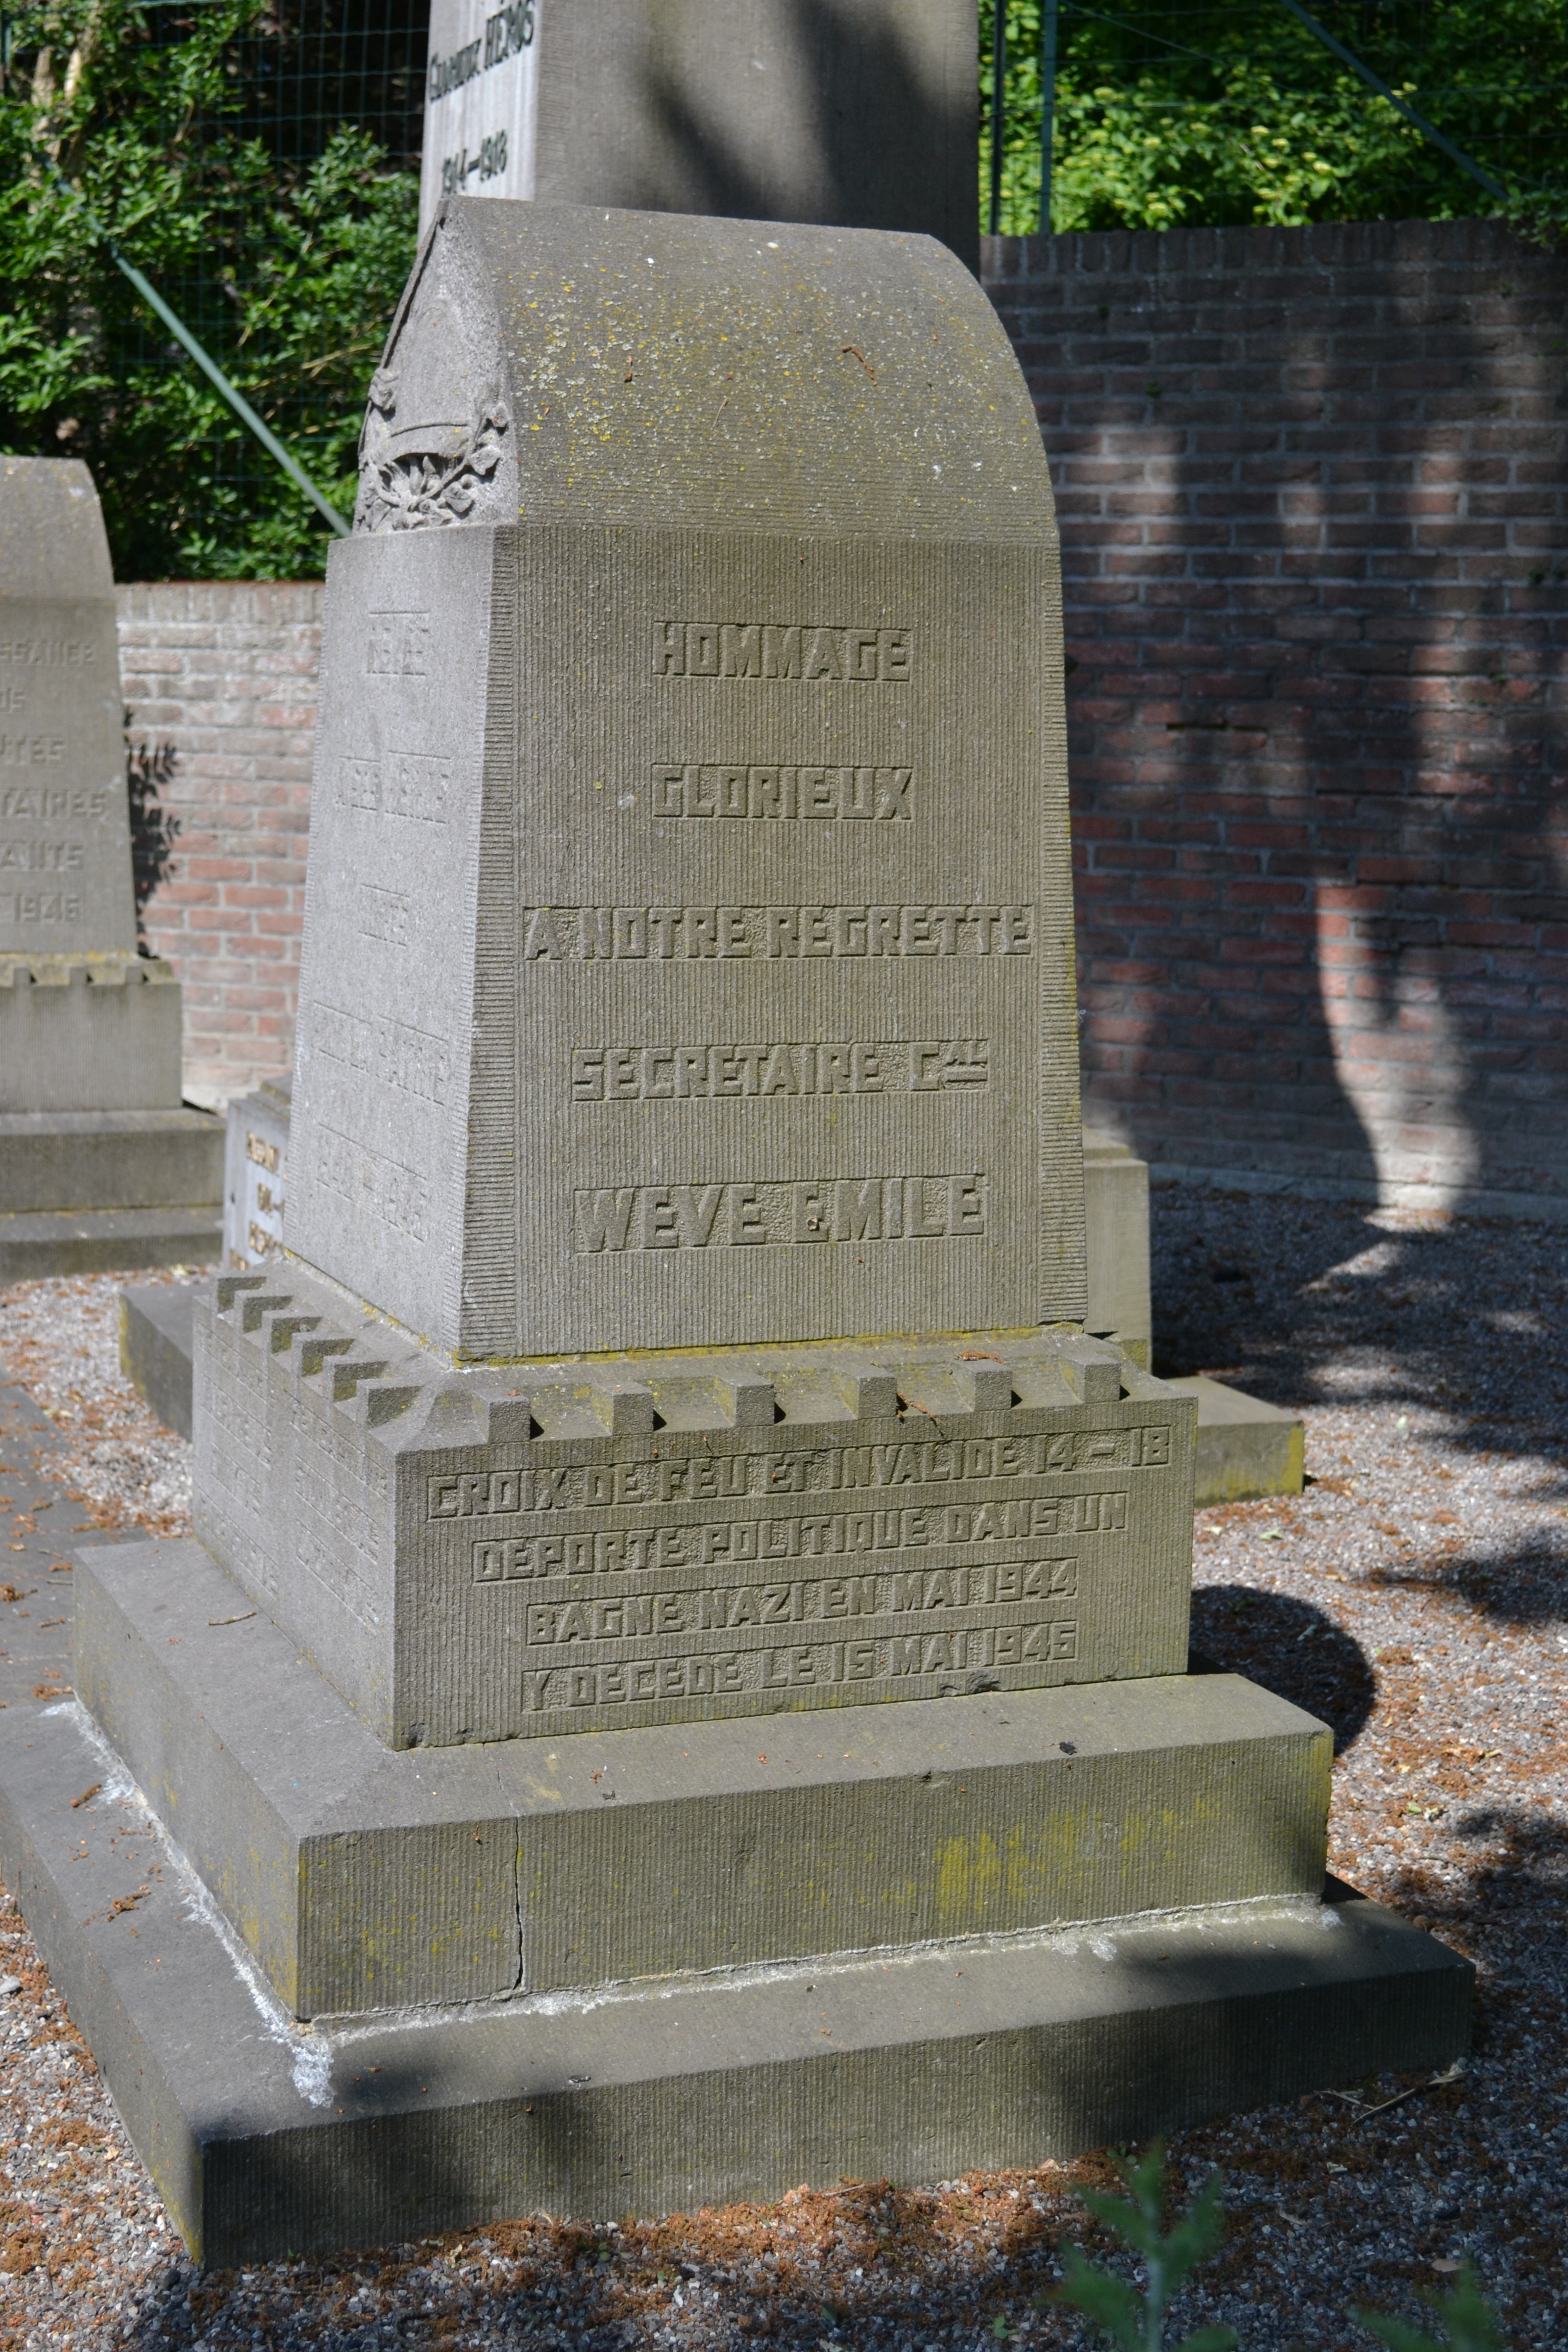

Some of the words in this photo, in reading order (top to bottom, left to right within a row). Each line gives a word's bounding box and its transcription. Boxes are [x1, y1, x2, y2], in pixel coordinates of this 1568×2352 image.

[653, 621, 911, 681] HOMMAGE
[652, 764, 912, 820] GLORIEUX
[524, 906, 562, 960] A
[580, 906, 749, 959] NOTRE
[767, 905, 1032, 958] REGRETTE
[572, 1042, 883, 1101] SECRETAIRE
[576, 1183, 765, 1252] WEVE
[792, 1174, 985, 1243] EMILE
[428, 1469, 565, 1521] CROIX
[584, 1462, 642, 1507] DE
[663, 1455, 748, 1501] FEU
[766, 1450, 808, 1493] ET
[829, 1437, 1019, 1489] INVALIDE
[473, 1528, 684, 1582] DEPORTE
[703, 1508, 927, 1565] POLITIQUE
[945, 1500, 1059, 1544] DANS
[1075, 1492, 1126, 1532] UN
[527, 1594, 682, 1645] BAGNE
[700, 1583, 803, 1630] NAZI
[821, 1576, 875, 1618] EN
[893, 1568, 969, 1612] MAI
[984, 1558, 1077, 1604] 1944
[522, 1670, 551, 1713] Y
[567, 1654, 743, 1707] DECEDE
[760, 1646, 817, 1689] LE
[831, 1641, 873, 1681] 15
[890, 1632, 968, 1676] MAI
[984, 1622, 1077, 1666] 1945
